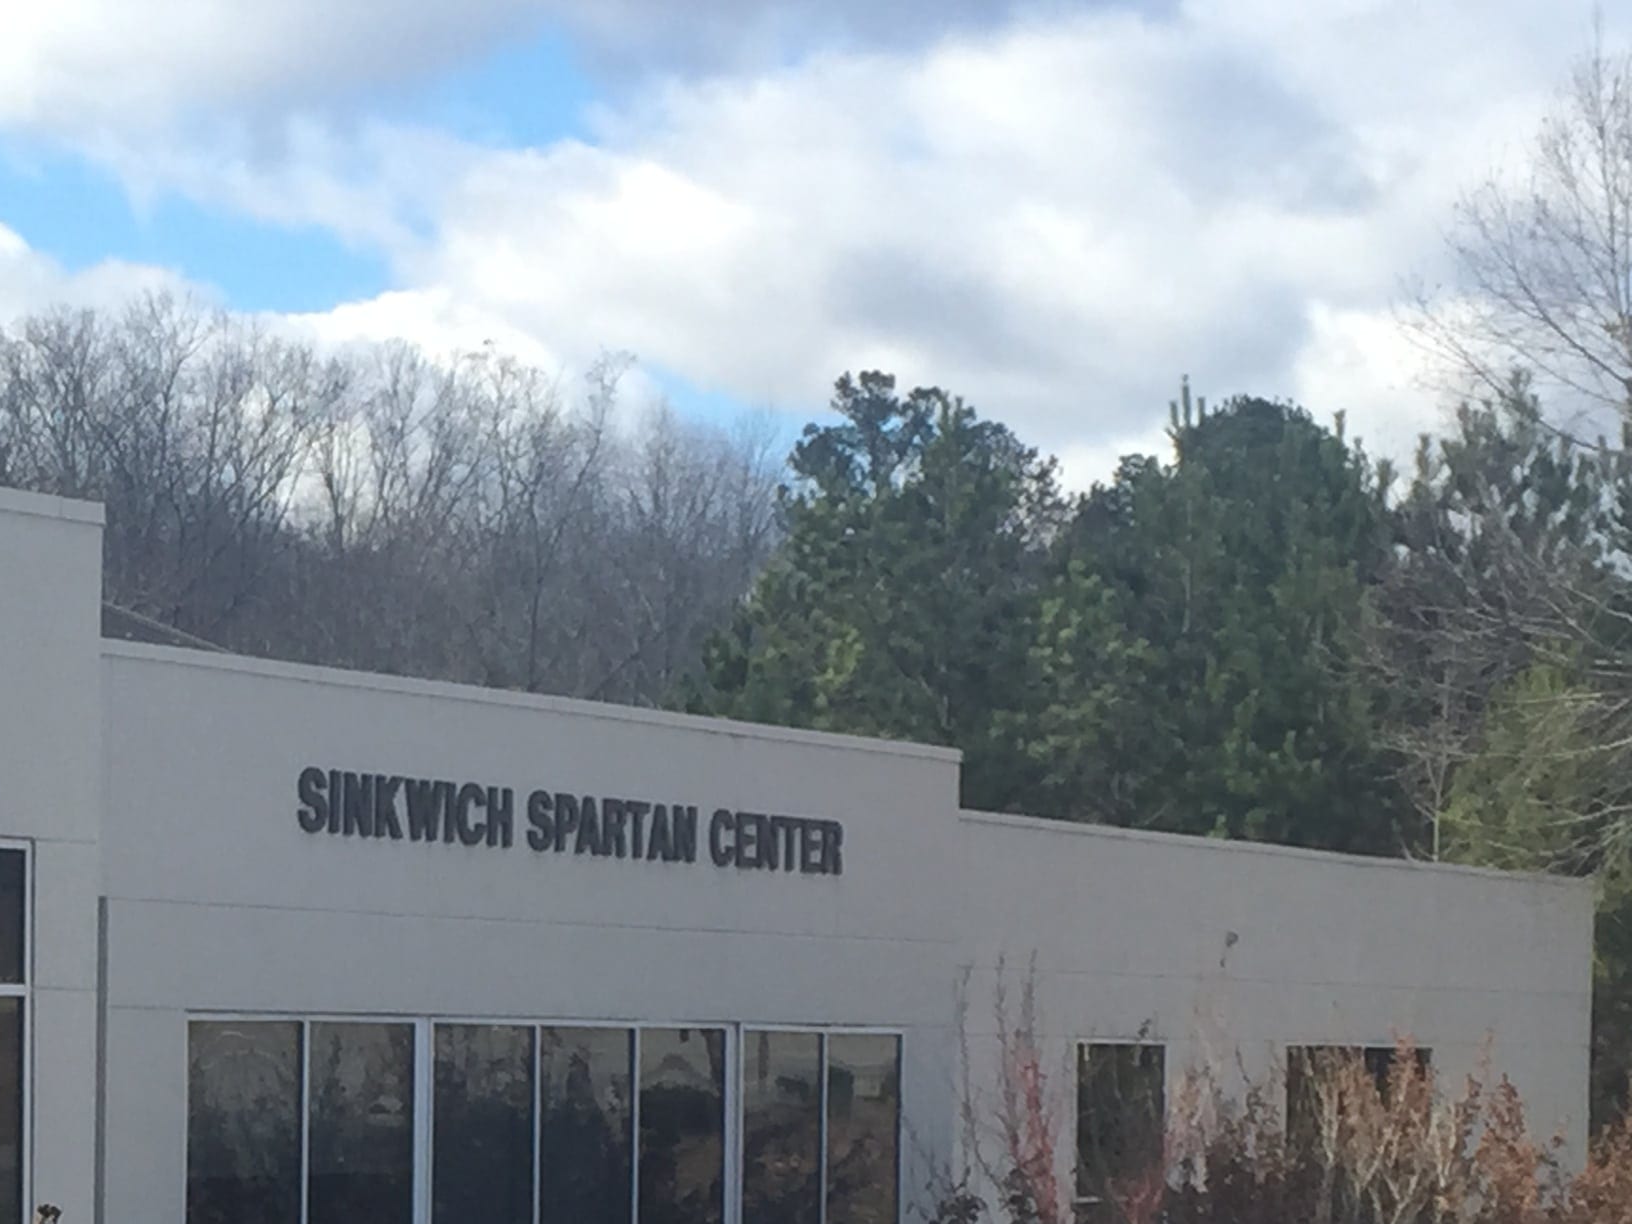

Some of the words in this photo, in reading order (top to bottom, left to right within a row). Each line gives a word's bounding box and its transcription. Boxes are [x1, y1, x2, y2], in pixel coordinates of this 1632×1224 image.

[297, 766, 514, 849] SINKWICH
[526, 789, 698, 863] SPARTAN
[710, 808, 844, 876] CENTER
